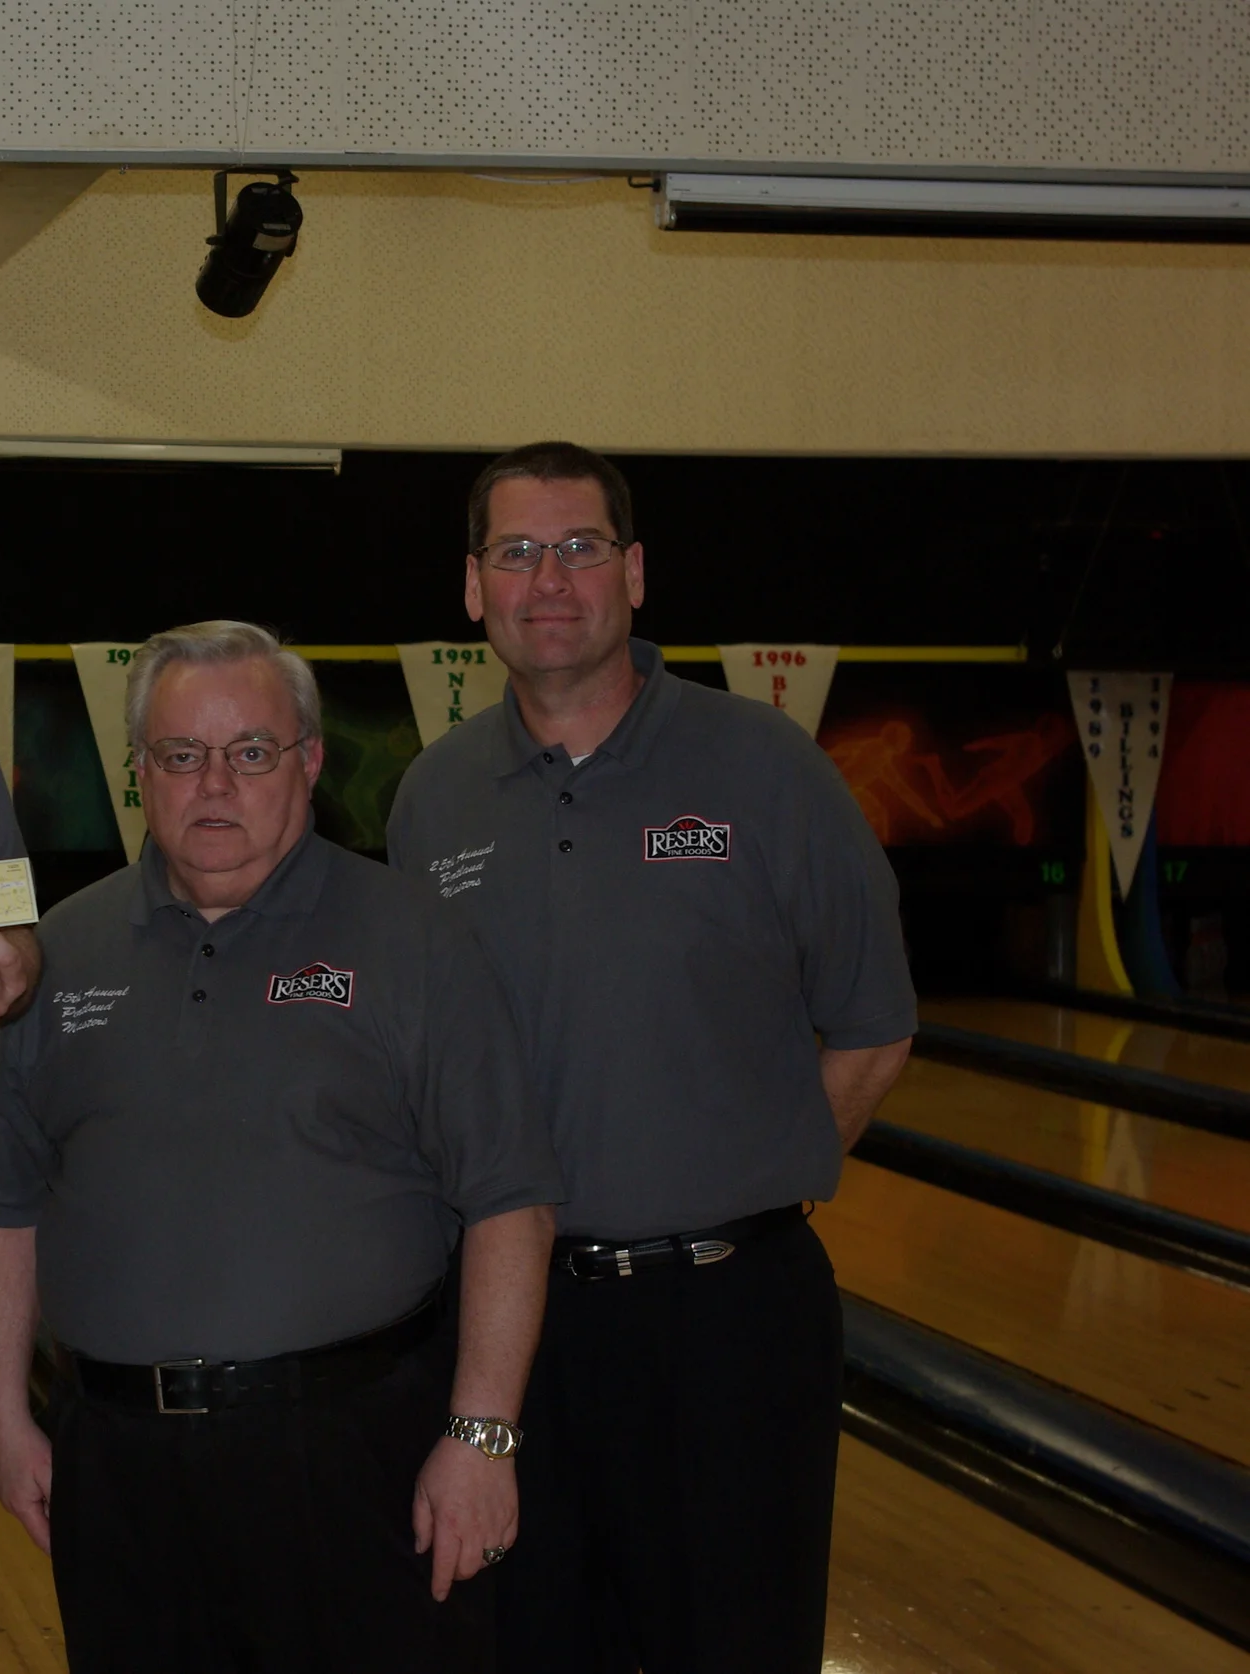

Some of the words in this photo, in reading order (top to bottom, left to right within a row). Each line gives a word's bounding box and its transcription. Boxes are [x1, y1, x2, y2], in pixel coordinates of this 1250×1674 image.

[107, 649, 138, 665] 19
[432, 648, 486, 664] 1991
[753, 649, 806, 667] 1996
[684, 848, 712, 856] FOODS
[1163, 860, 1188, 884] 17
[82, 986, 130, 1000] Annual
[306, 990, 332, 999] FOODS
